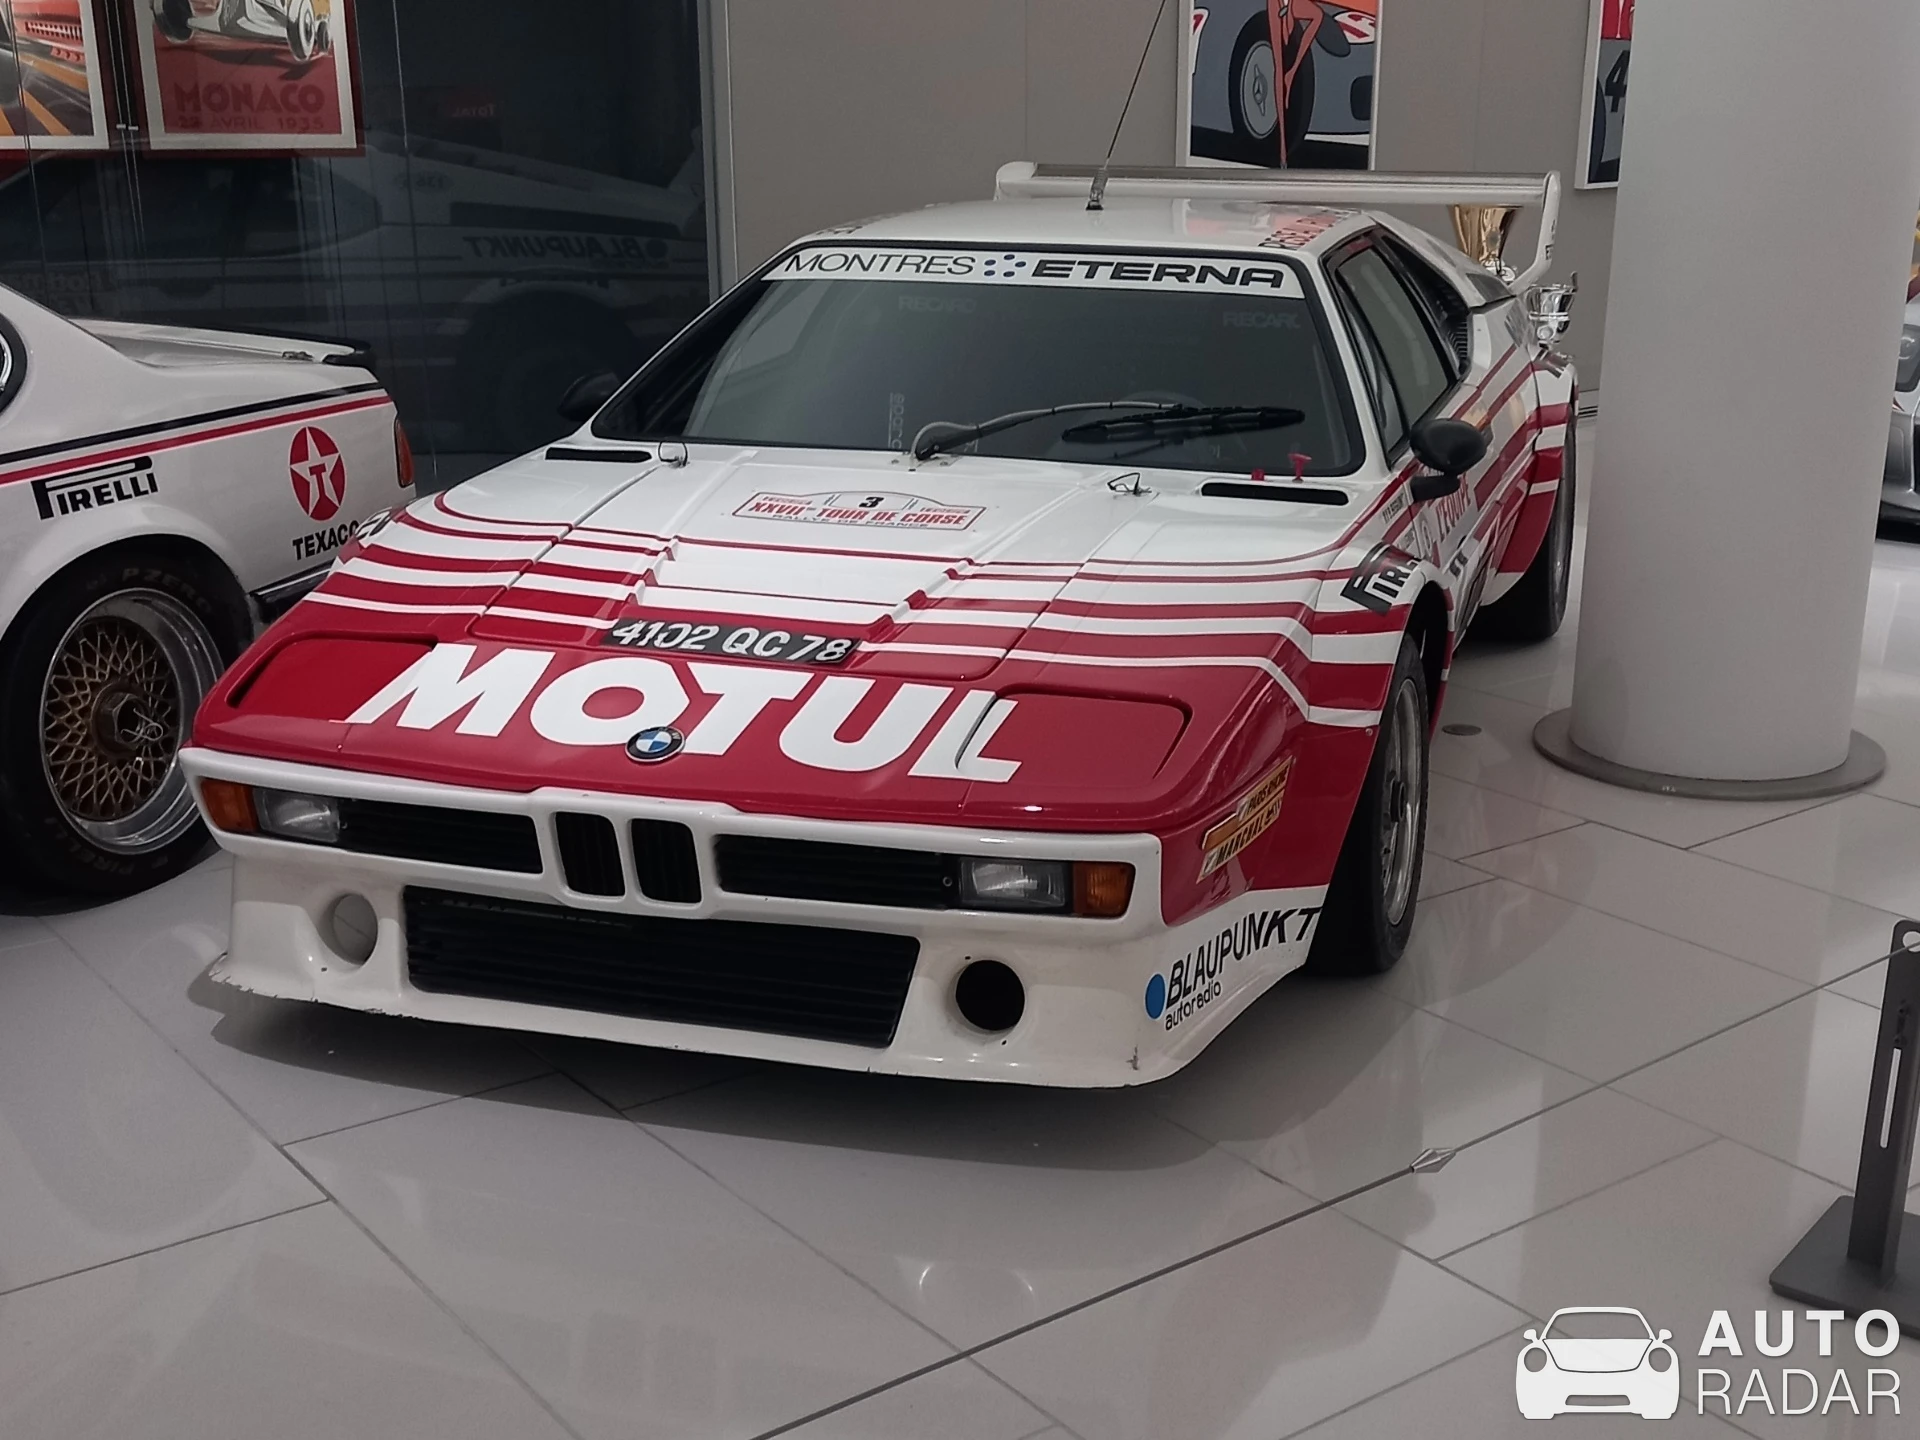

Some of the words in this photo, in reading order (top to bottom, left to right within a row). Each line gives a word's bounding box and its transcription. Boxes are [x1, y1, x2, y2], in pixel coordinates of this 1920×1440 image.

[174, 81, 326, 114] MONACO
[784, 253, 976, 275] MONTRES
[1031, 260, 1284, 288] ETERNA
[30, 456, 158, 520] PIRELLI
[859, 497, 884, 508] 3
[817, 508, 870, 521] TOUR
[872, 511, 899, 522] DE
[900, 512, 968, 525] CORSE
[722, 628, 791, 656] QC
[787, 635, 852, 661] 78
[340, 643, 1022, 782] MOTUL
[1166, 906, 1323, 999] BLAUPUNKT
[1165, 981, 1221, 1030] autoradio
